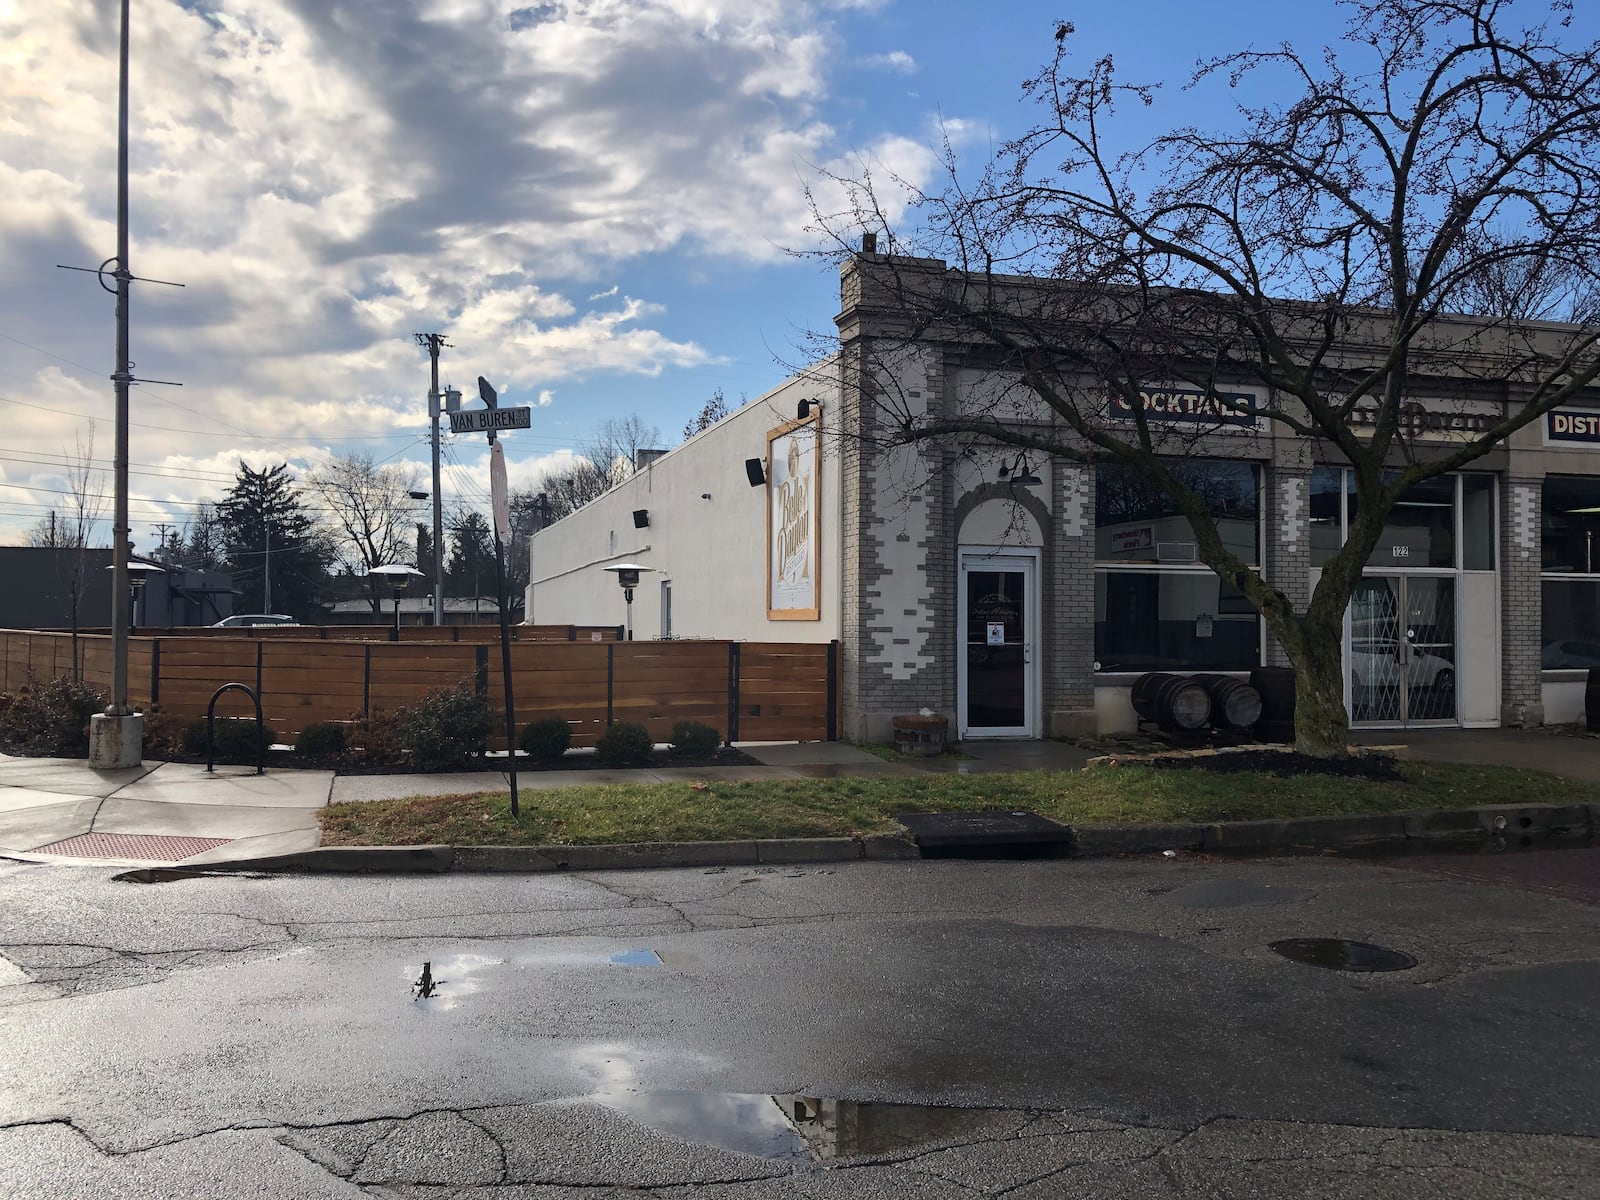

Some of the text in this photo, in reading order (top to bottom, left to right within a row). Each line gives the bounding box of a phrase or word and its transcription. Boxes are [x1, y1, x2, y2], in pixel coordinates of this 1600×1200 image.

[451, 410, 526, 430] VAN BUREN ST
[516, 417, 528, 426] 100
[1554, 415, 1600, 435] DIST
[780, 477, 803, 528] Belle
[778, 510, 809, 577] Dayton
[1394, 545, 1408, 557] 122
